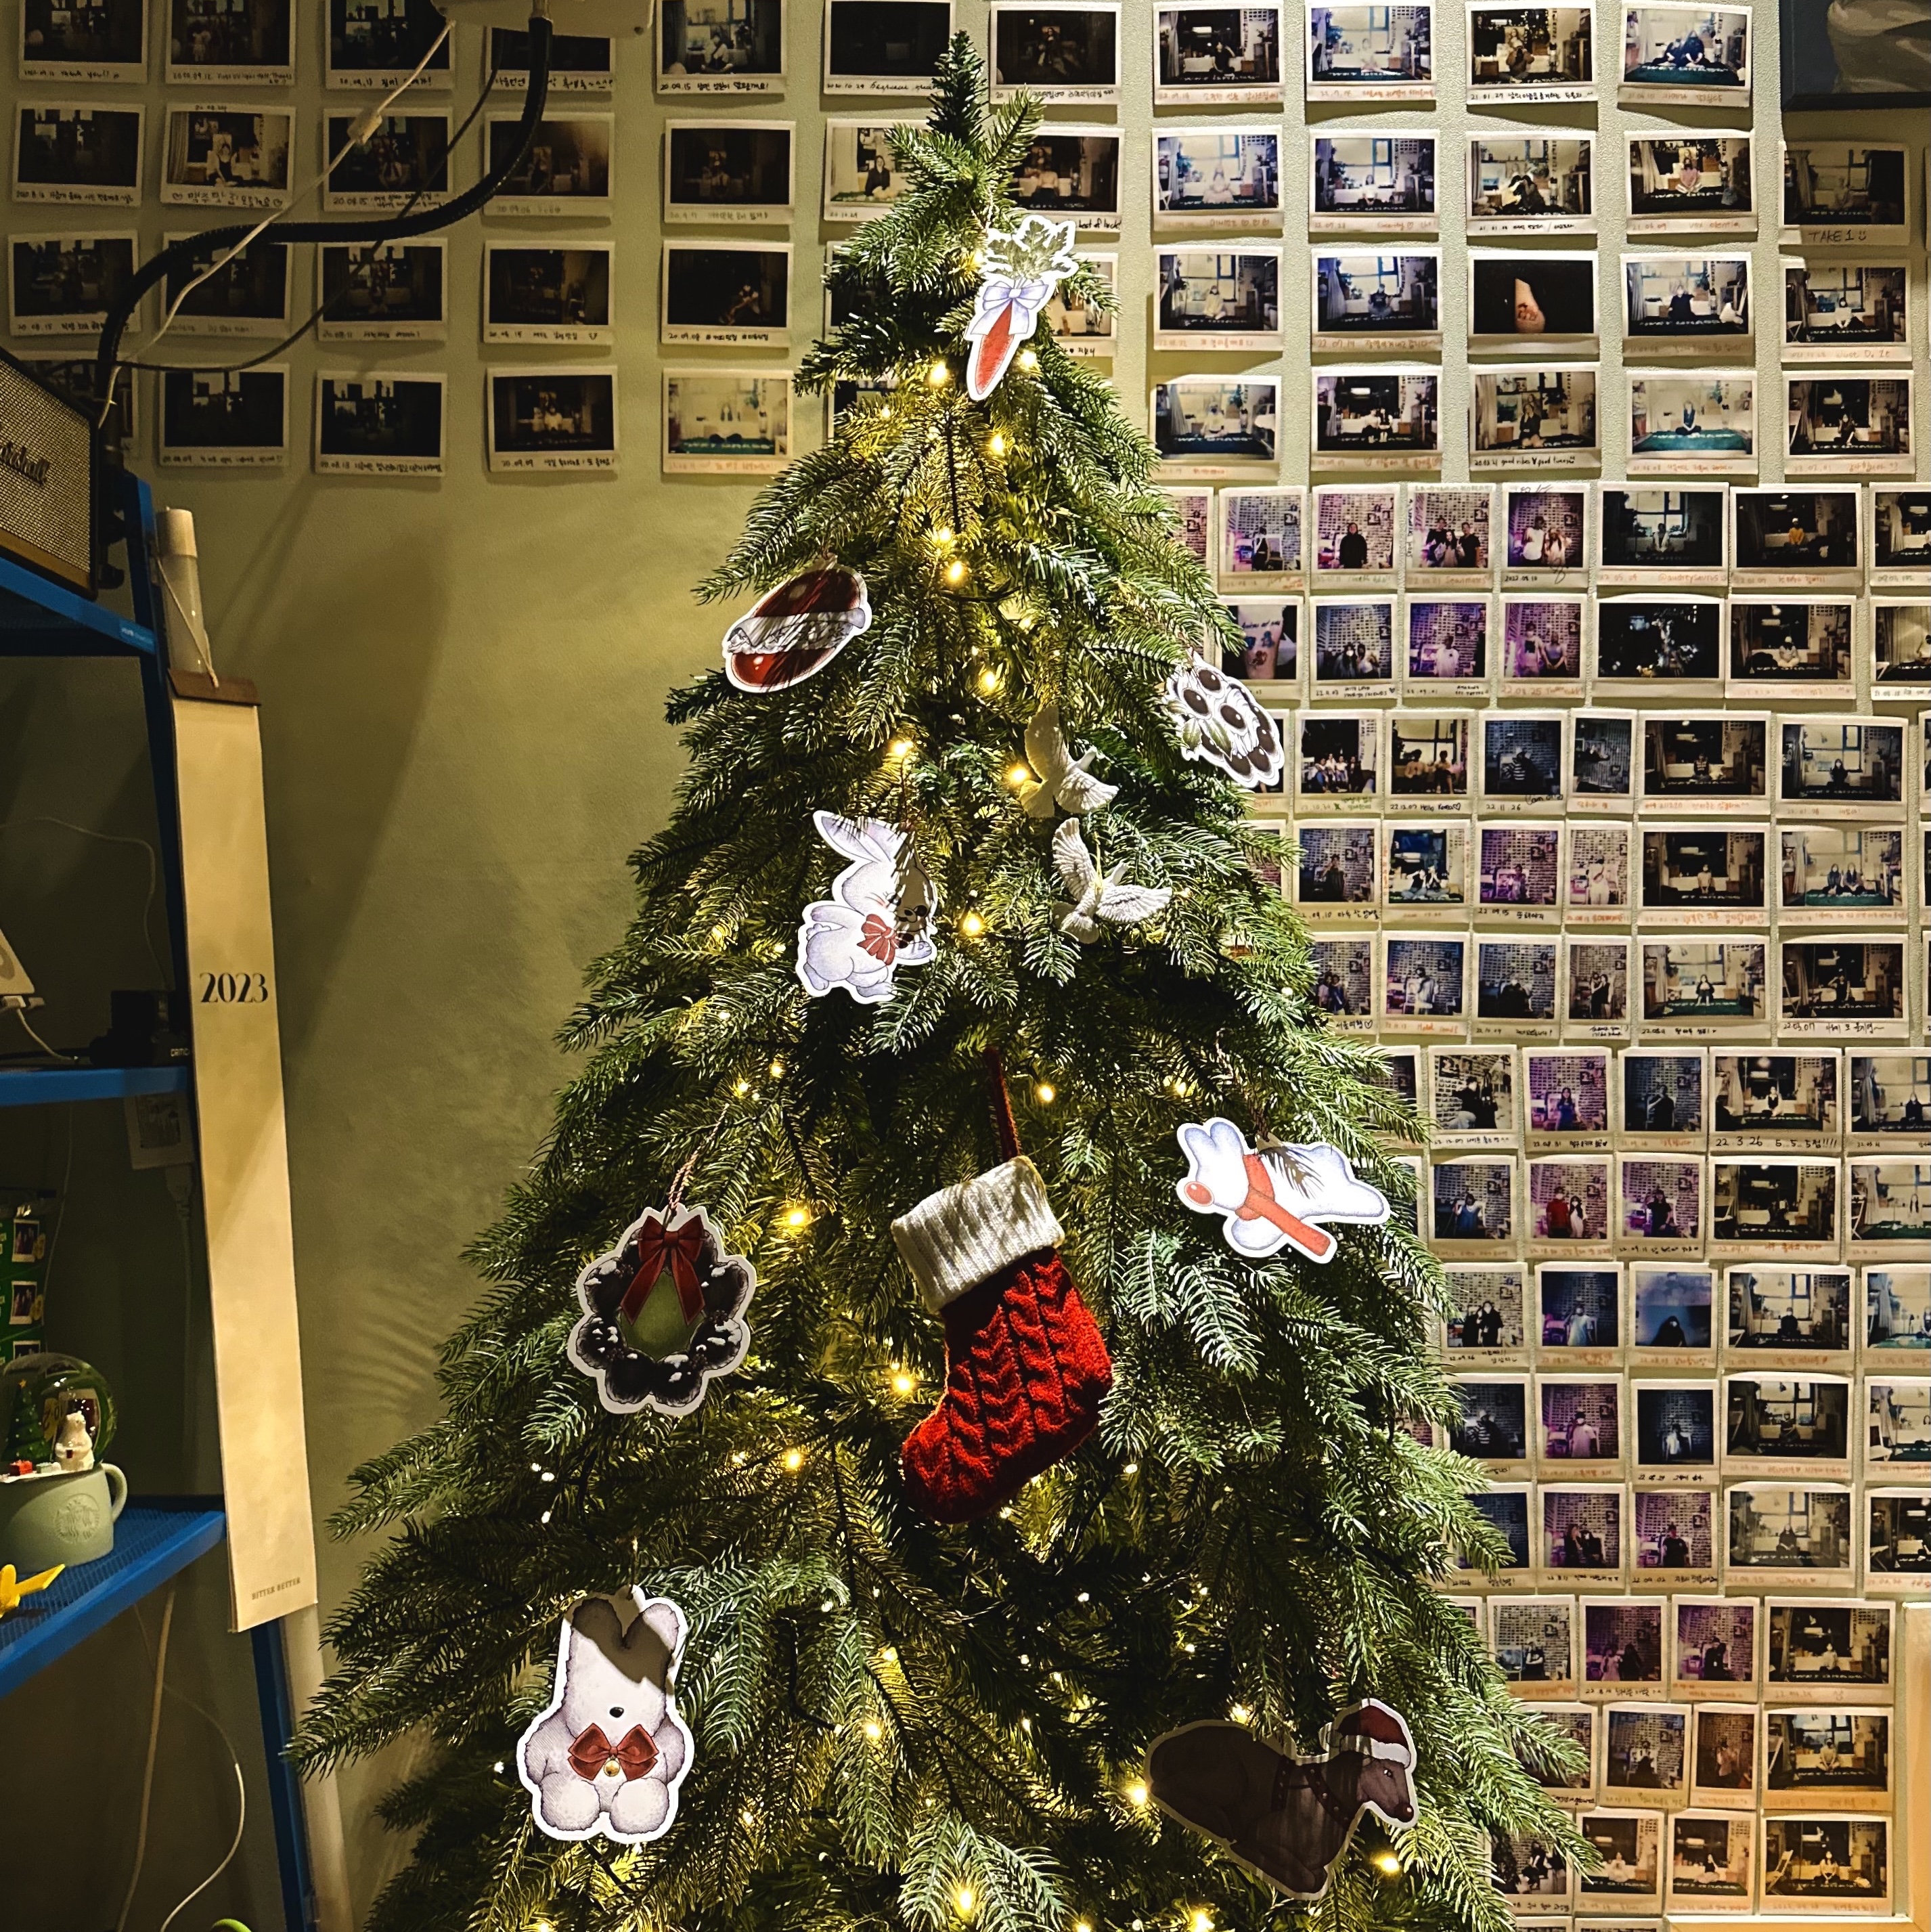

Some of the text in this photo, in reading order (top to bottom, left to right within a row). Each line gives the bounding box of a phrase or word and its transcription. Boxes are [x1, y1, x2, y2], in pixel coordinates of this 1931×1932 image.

[1808, 229, 1855, 242] TAKE 1
[199, 971, 269, 1003] 2023
[252, 1577, 301, 1600] BITTER BETTER
